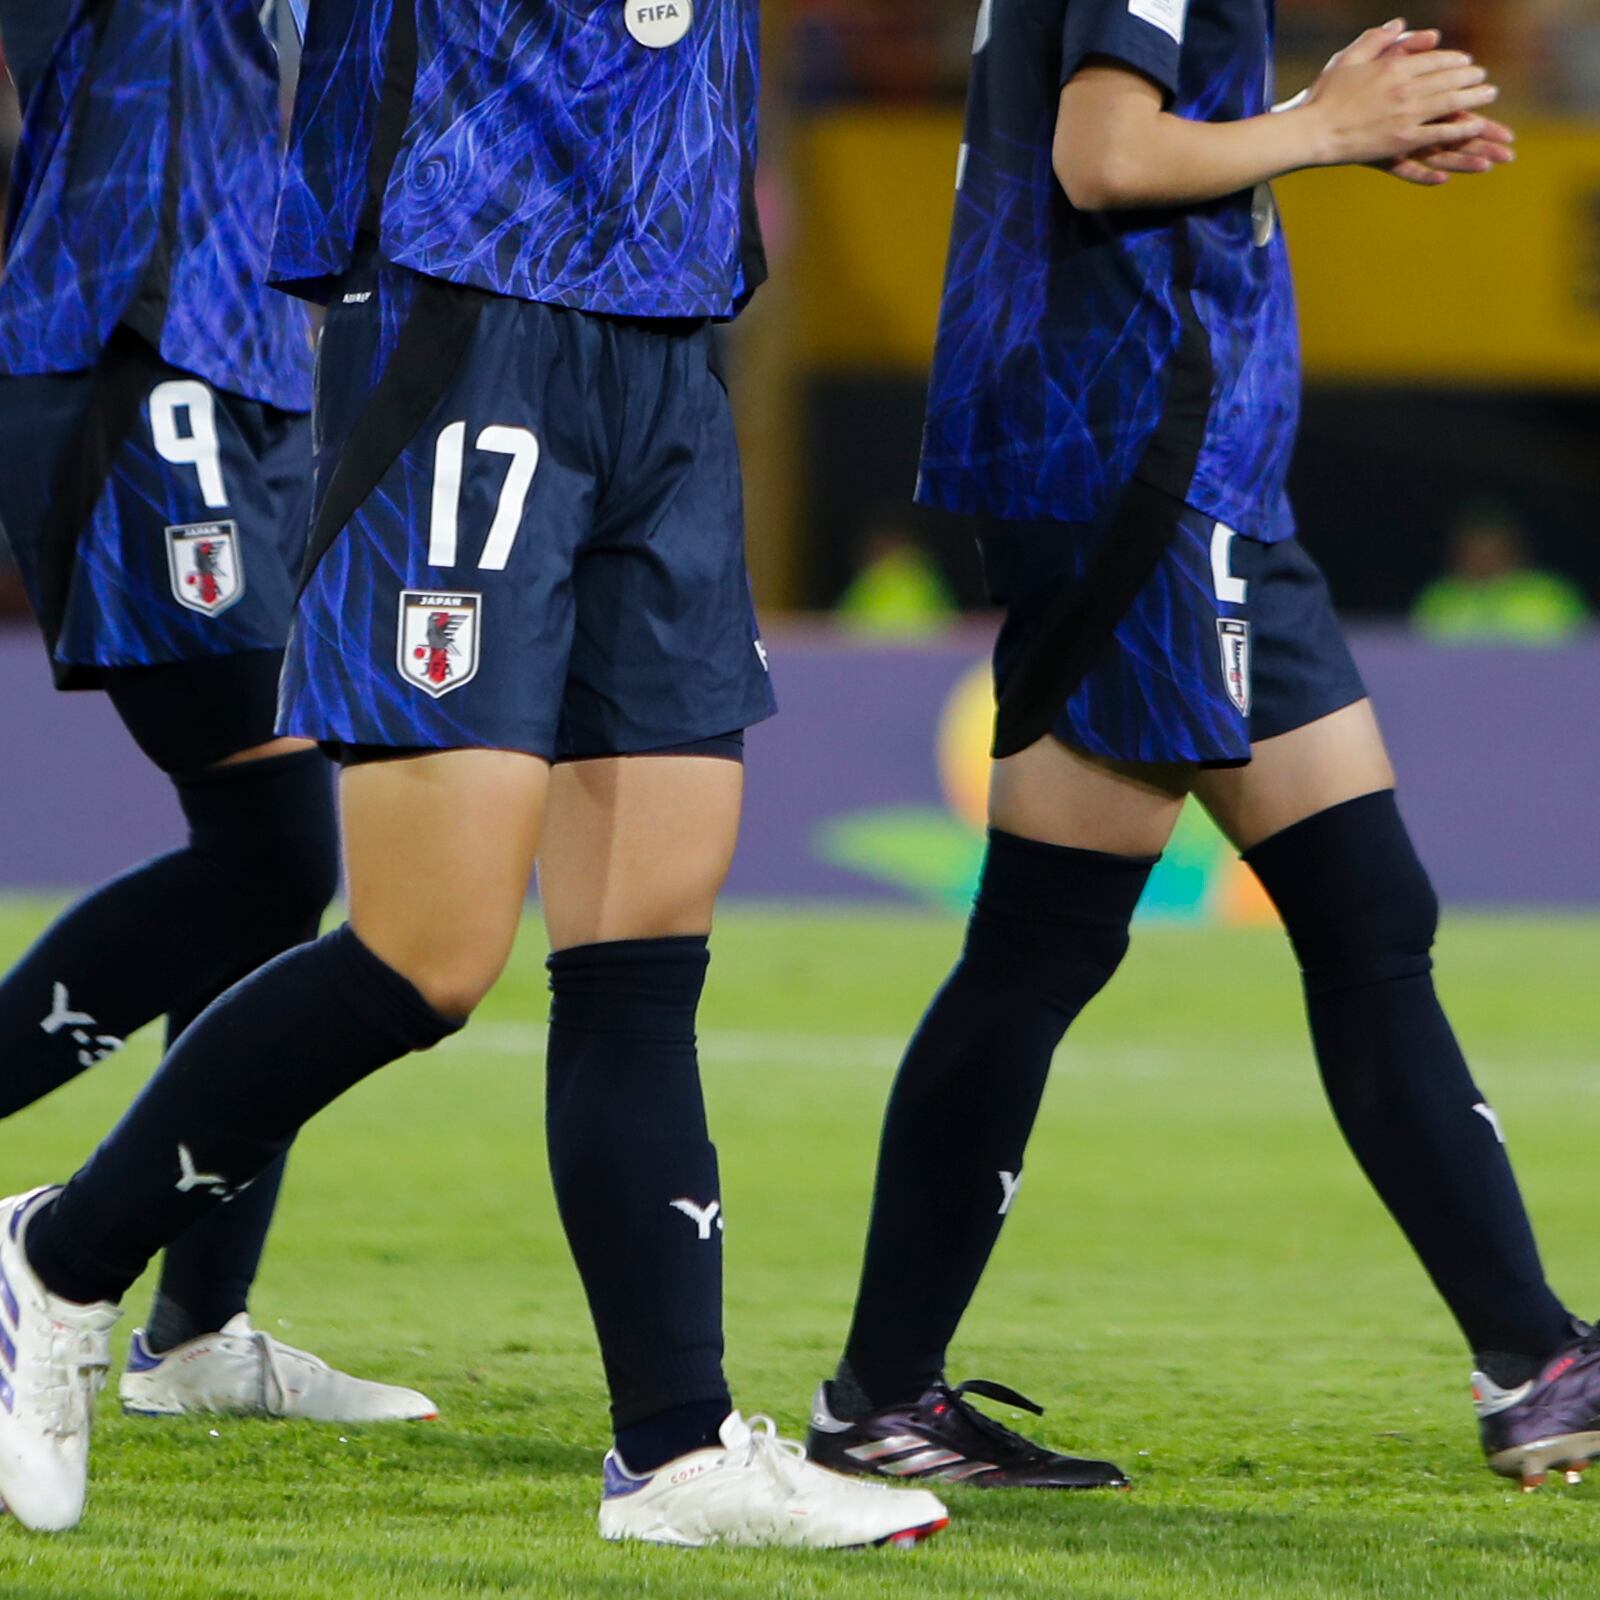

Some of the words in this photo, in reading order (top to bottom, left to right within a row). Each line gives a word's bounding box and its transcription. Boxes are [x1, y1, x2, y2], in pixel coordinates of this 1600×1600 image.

[637, 3, 680, 24] FIFA
[146, 379, 228, 508] 9
[427, 420, 539, 571] 17
[419, 596, 463, 607] JAPAN
